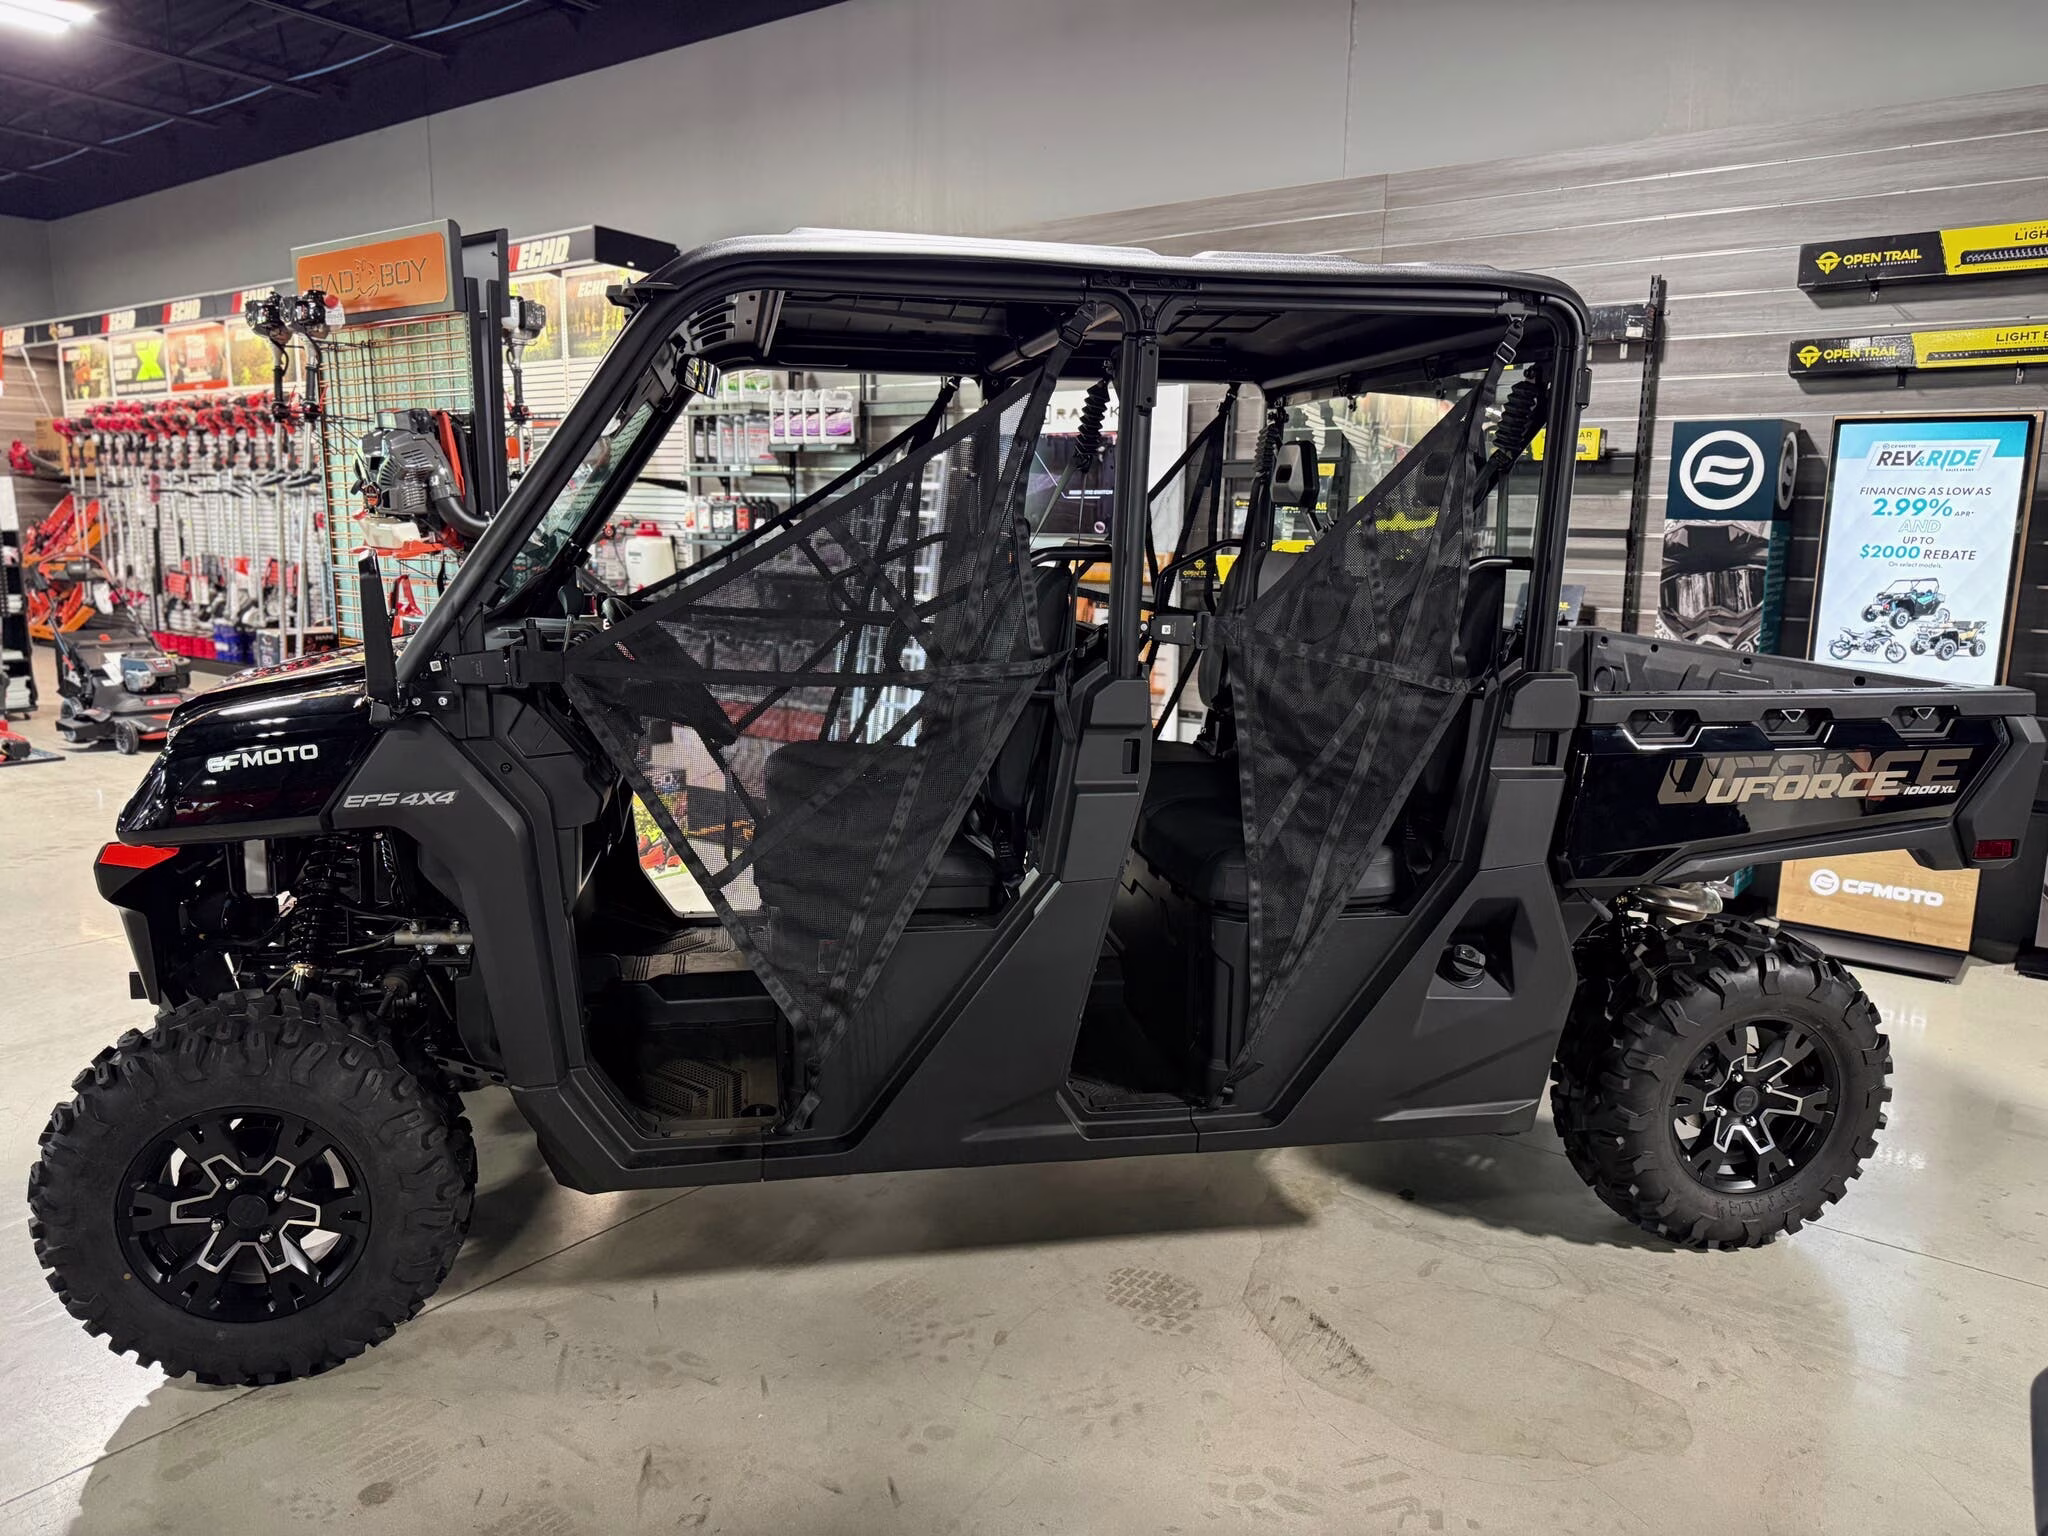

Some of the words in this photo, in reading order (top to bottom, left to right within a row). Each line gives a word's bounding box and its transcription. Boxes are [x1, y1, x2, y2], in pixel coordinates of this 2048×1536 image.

[517, 235, 570, 269] ECHO
[1843, 251, 1882, 266] OPEN
[1885, 248, 1922, 261] TRAIL
[380, 257, 427, 287] BOY
[578, 279, 609, 297] ECHO
[1995, 330, 2040, 342] LIGHT
[1823, 348, 1861, 360] OPEN
[1863, 345, 1900, 358] TRAIL
[1859, 486, 1926, 496] FINANCING
[1928, 487, 1944, 496] AS
[1946, 487, 1975, 496] LOW
[1975, 487, 1992, 496] AS
[1871, 498, 1953, 517] 2.99%
[1898, 519, 1942, 533] AND
[1902, 536, 1918, 545] UP
[1919, 536, 1935, 545] TO
[1859, 544, 1921, 559] $2000
[1923, 549, 1977, 561] REBATE
[207, 743, 319, 773] CFMOTO
[1705, 770, 1909, 805] UFORCE
[343, 793, 398, 809] EPS
[1842, 878, 1944, 908] CFMOTO
